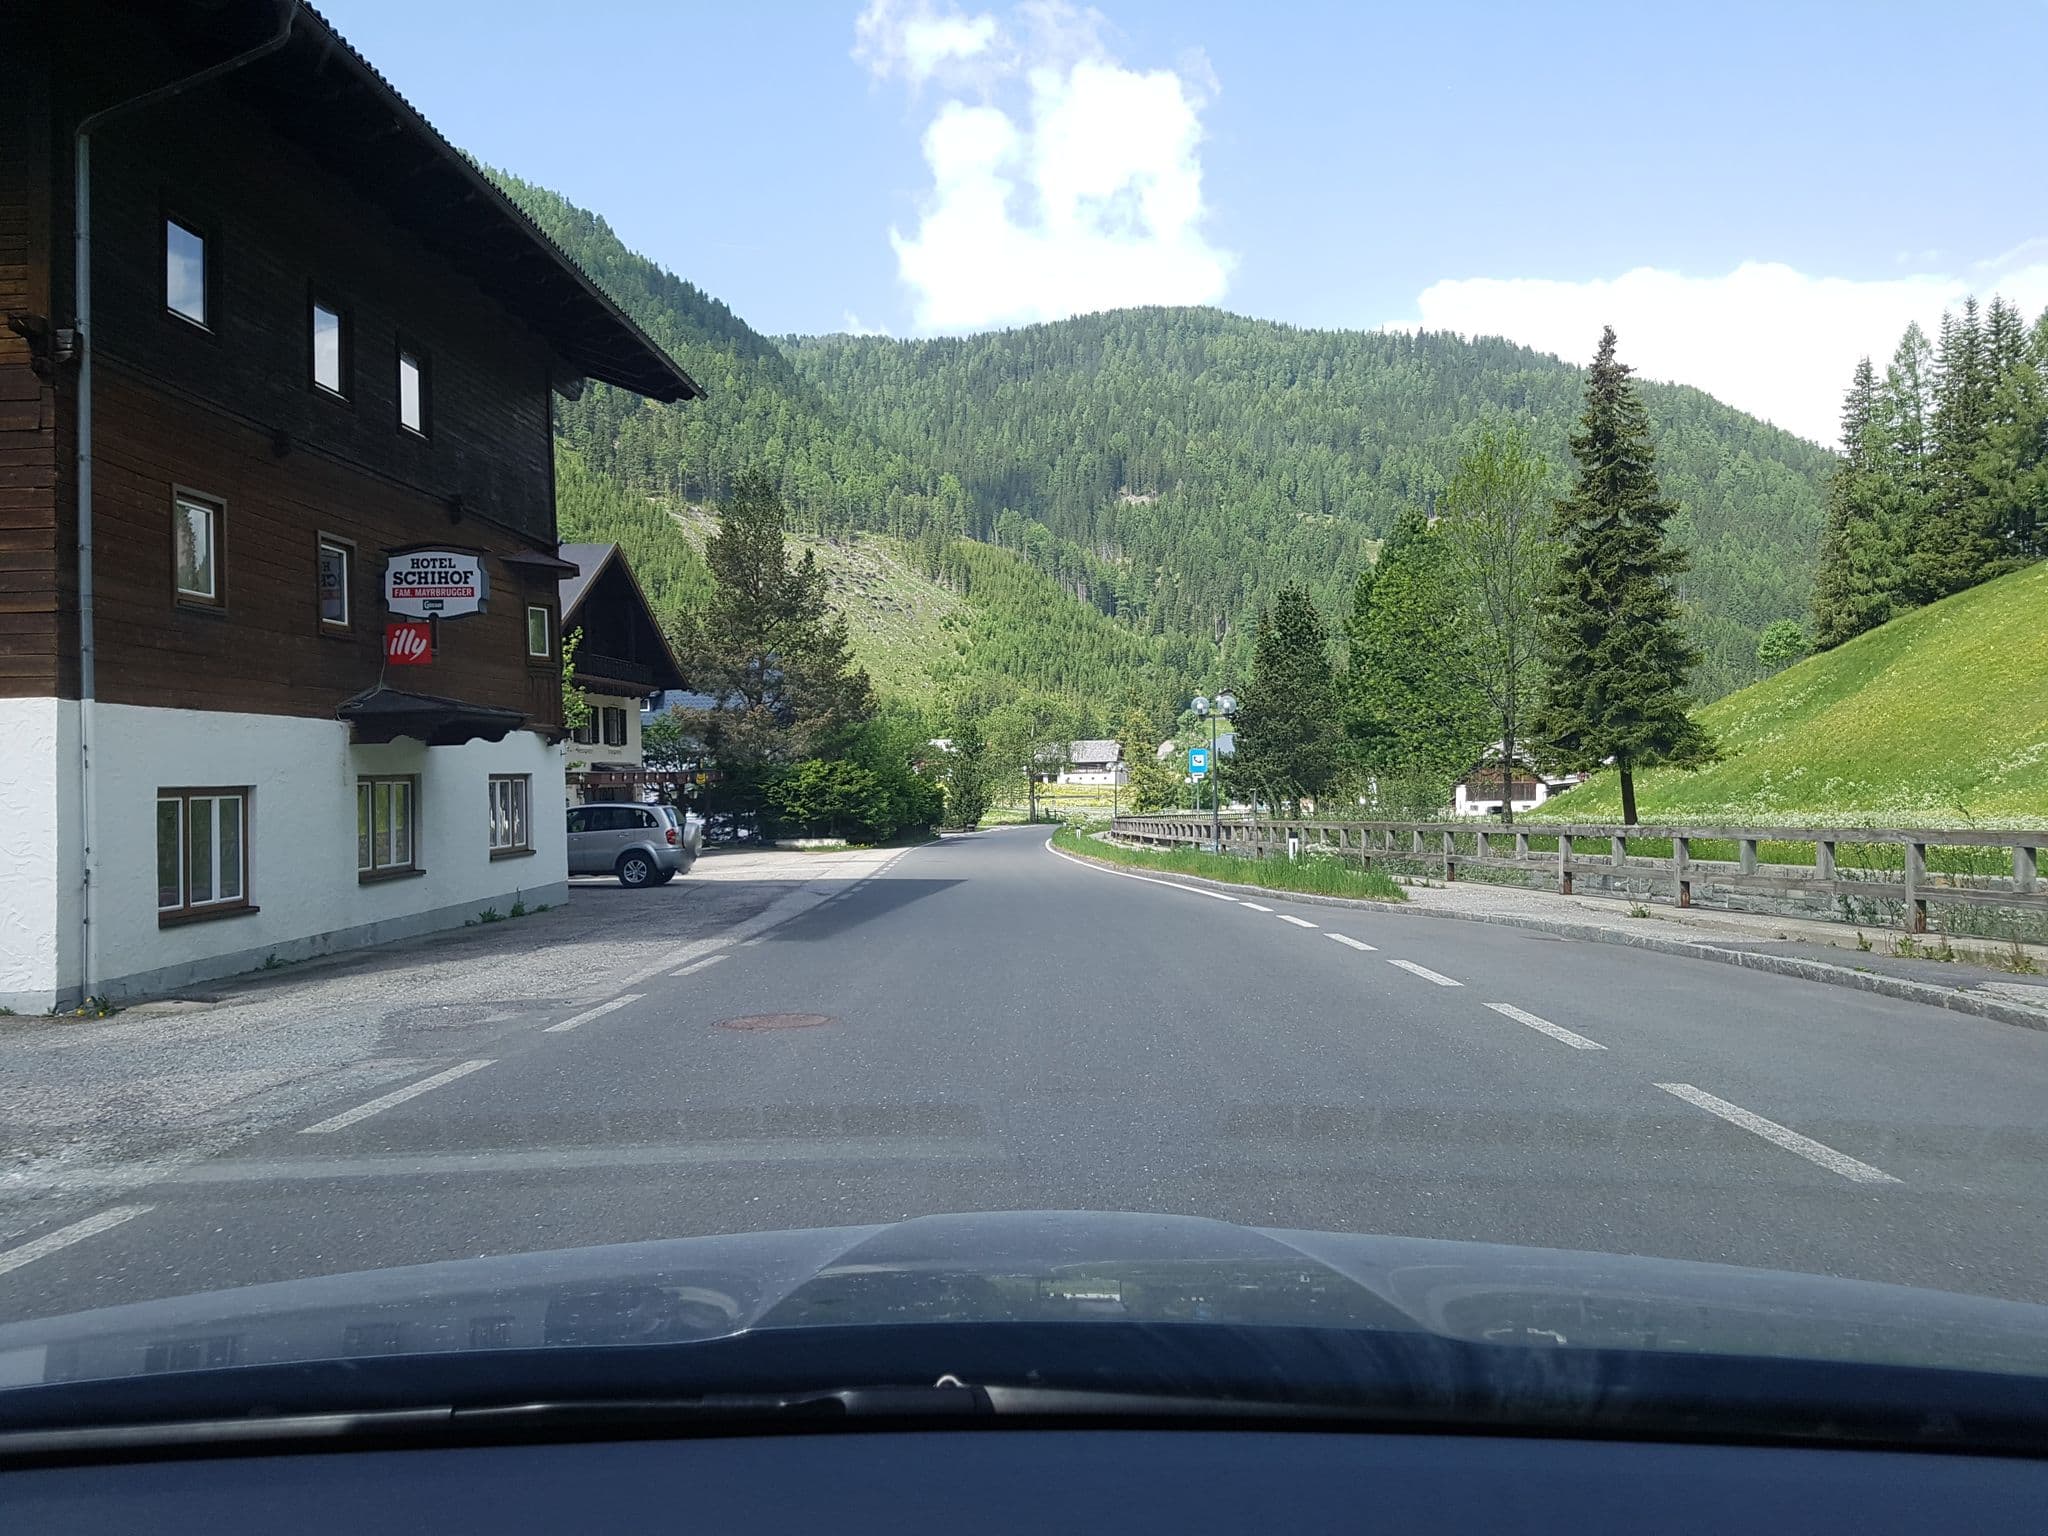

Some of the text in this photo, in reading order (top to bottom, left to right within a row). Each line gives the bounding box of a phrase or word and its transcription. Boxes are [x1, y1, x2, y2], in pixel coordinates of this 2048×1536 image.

[411, 558, 456, 569] HOTEL
[393, 571, 473, 585] SCHIHOF
[394, 588, 413, 597] FAM.
[390, 628, 427, 661] illy
